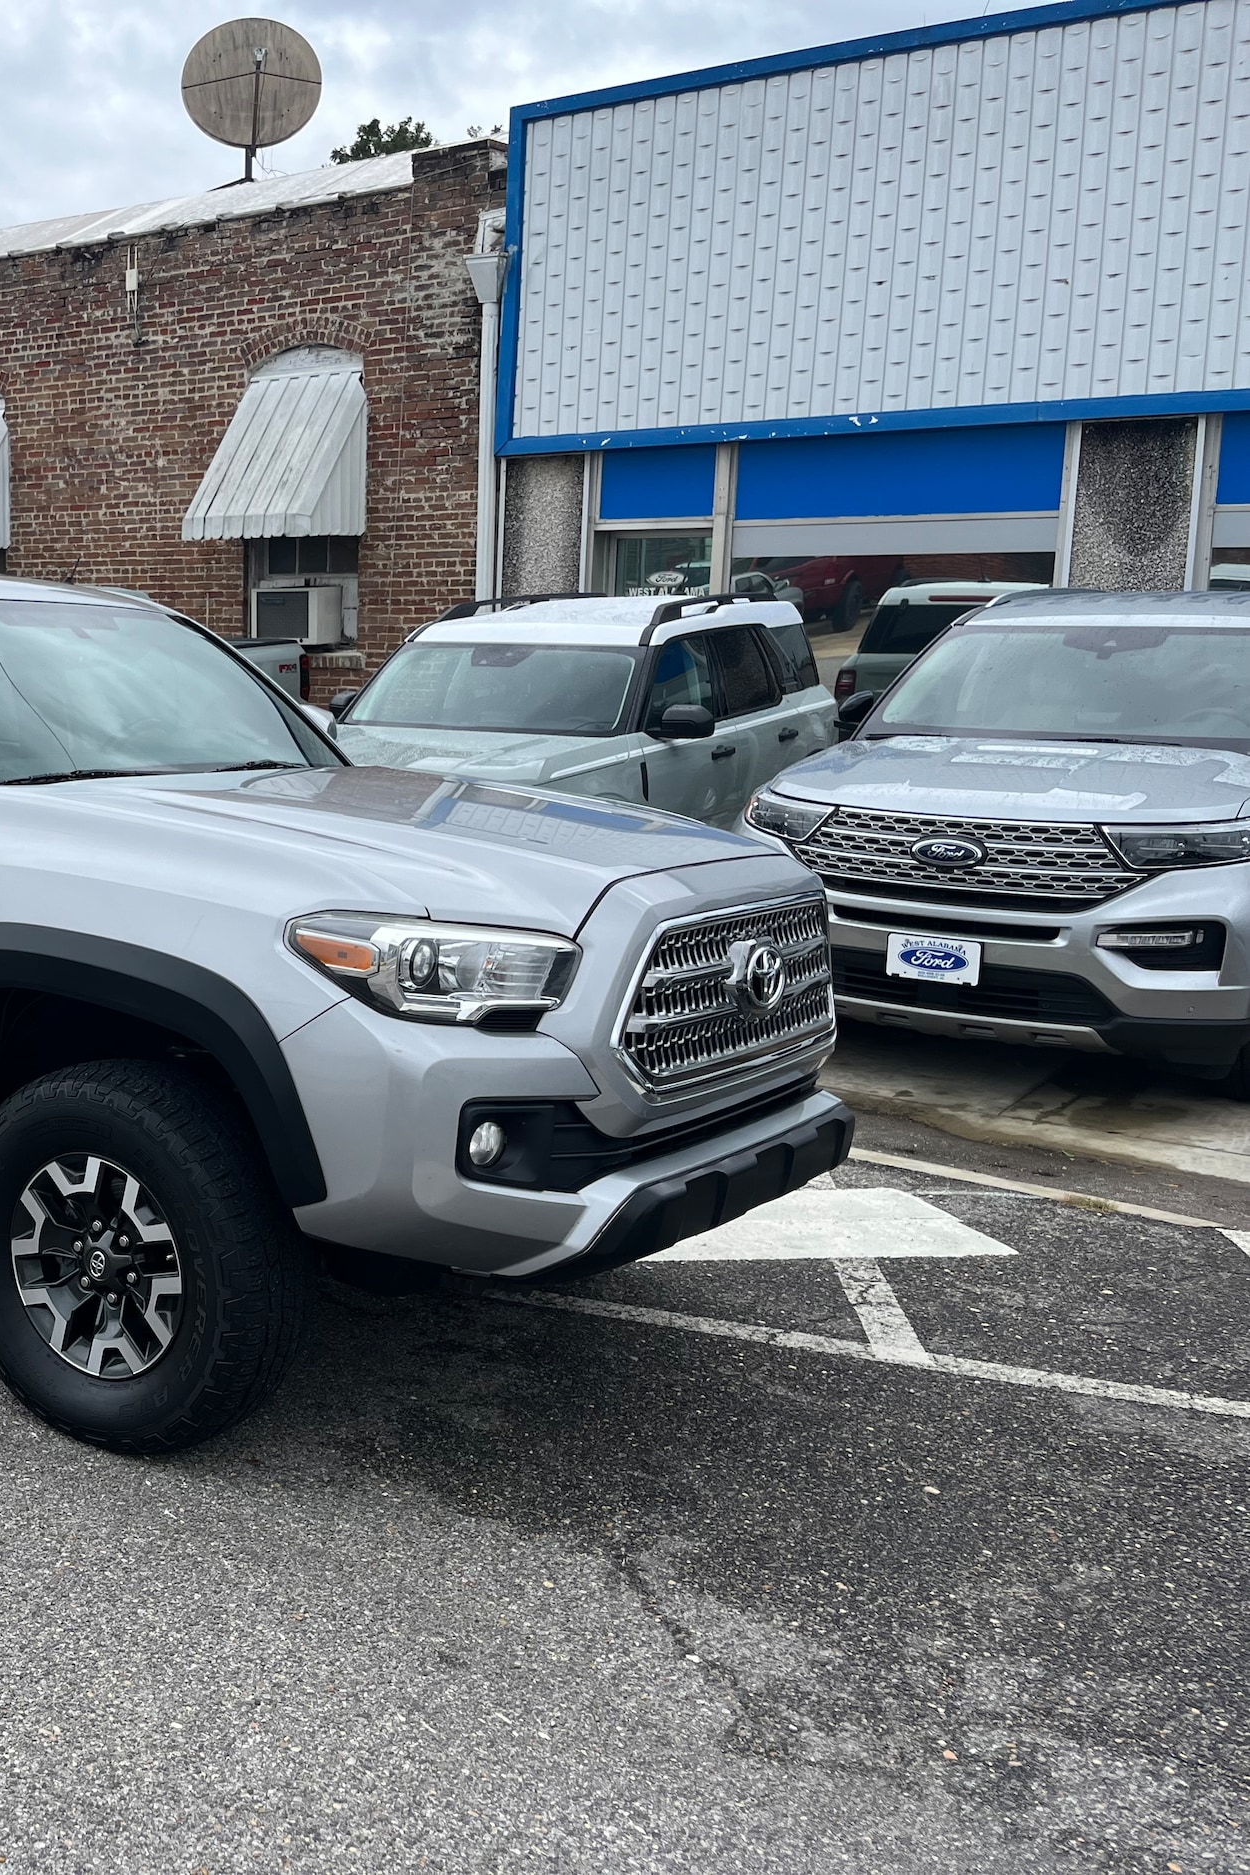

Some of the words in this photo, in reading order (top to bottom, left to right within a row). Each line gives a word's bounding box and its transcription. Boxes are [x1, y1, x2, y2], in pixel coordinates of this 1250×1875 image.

[655, 573, 679, 583] Ford
[628, 588, 656, 597] WEST
[658, 587, 705, 597] ALAAMA
[278, 663, 298, 673] FX4
[927, 843, 965, 860] Ford
[901, 940, 925, 949] WEST
[927, 940, 967, 956] ALABAMA
[910, 949, 955, 969] Ford
